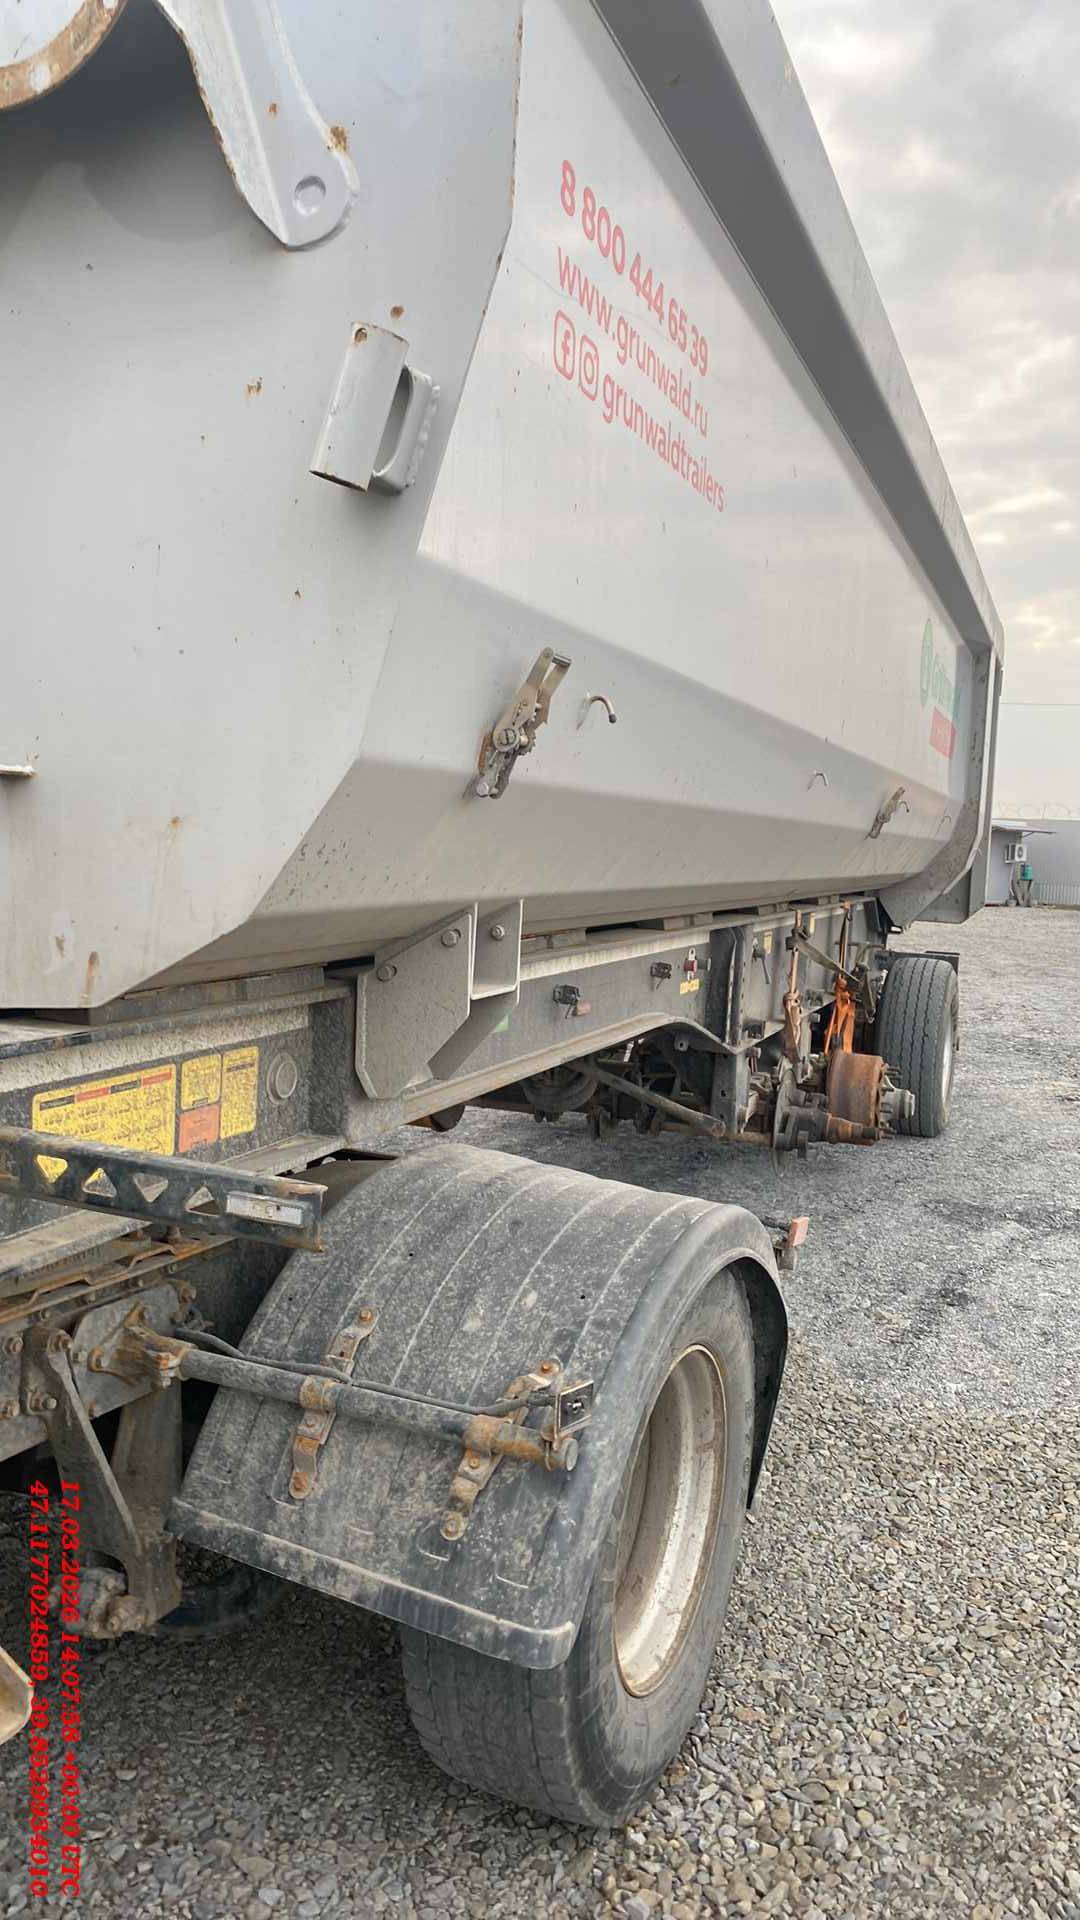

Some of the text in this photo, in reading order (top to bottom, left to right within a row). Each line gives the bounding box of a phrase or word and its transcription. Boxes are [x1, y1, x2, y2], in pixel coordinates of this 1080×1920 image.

[557, 246, 709, 439] www.grunwald.ru
[560, 160, 709, 377] 8 800 444 65 39
[601, 373, 726, 513] grunwaldtrailers
